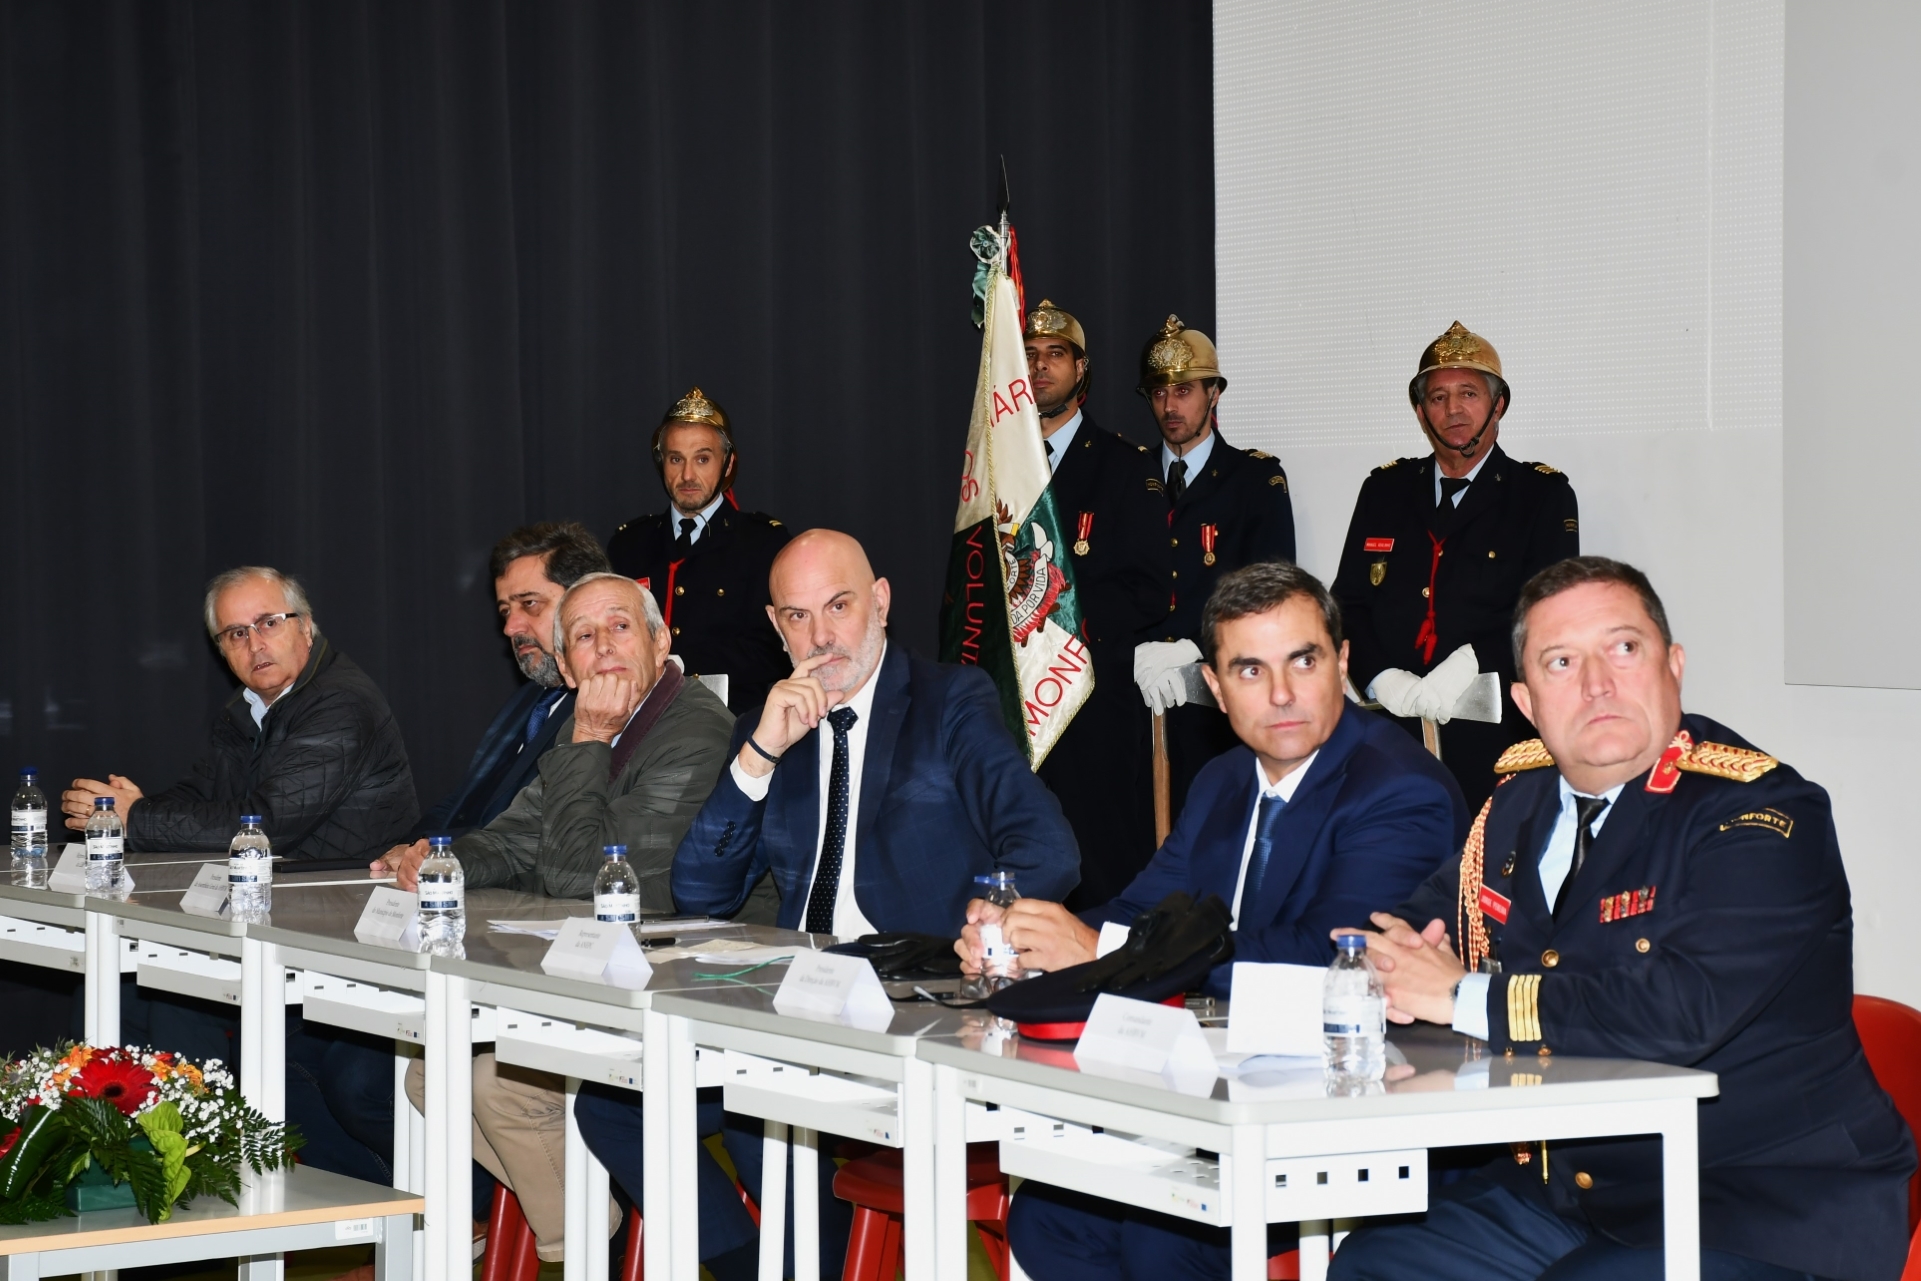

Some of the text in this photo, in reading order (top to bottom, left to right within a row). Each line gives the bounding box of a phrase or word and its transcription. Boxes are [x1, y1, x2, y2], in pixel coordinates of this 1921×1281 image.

[960, 525, 984, 666] VOLUNT
[1022, 594, 1041, 614] POR
[1035, 566, 1046, 594] VIDA
[1727, 812, 1787, 828] NFORTE
